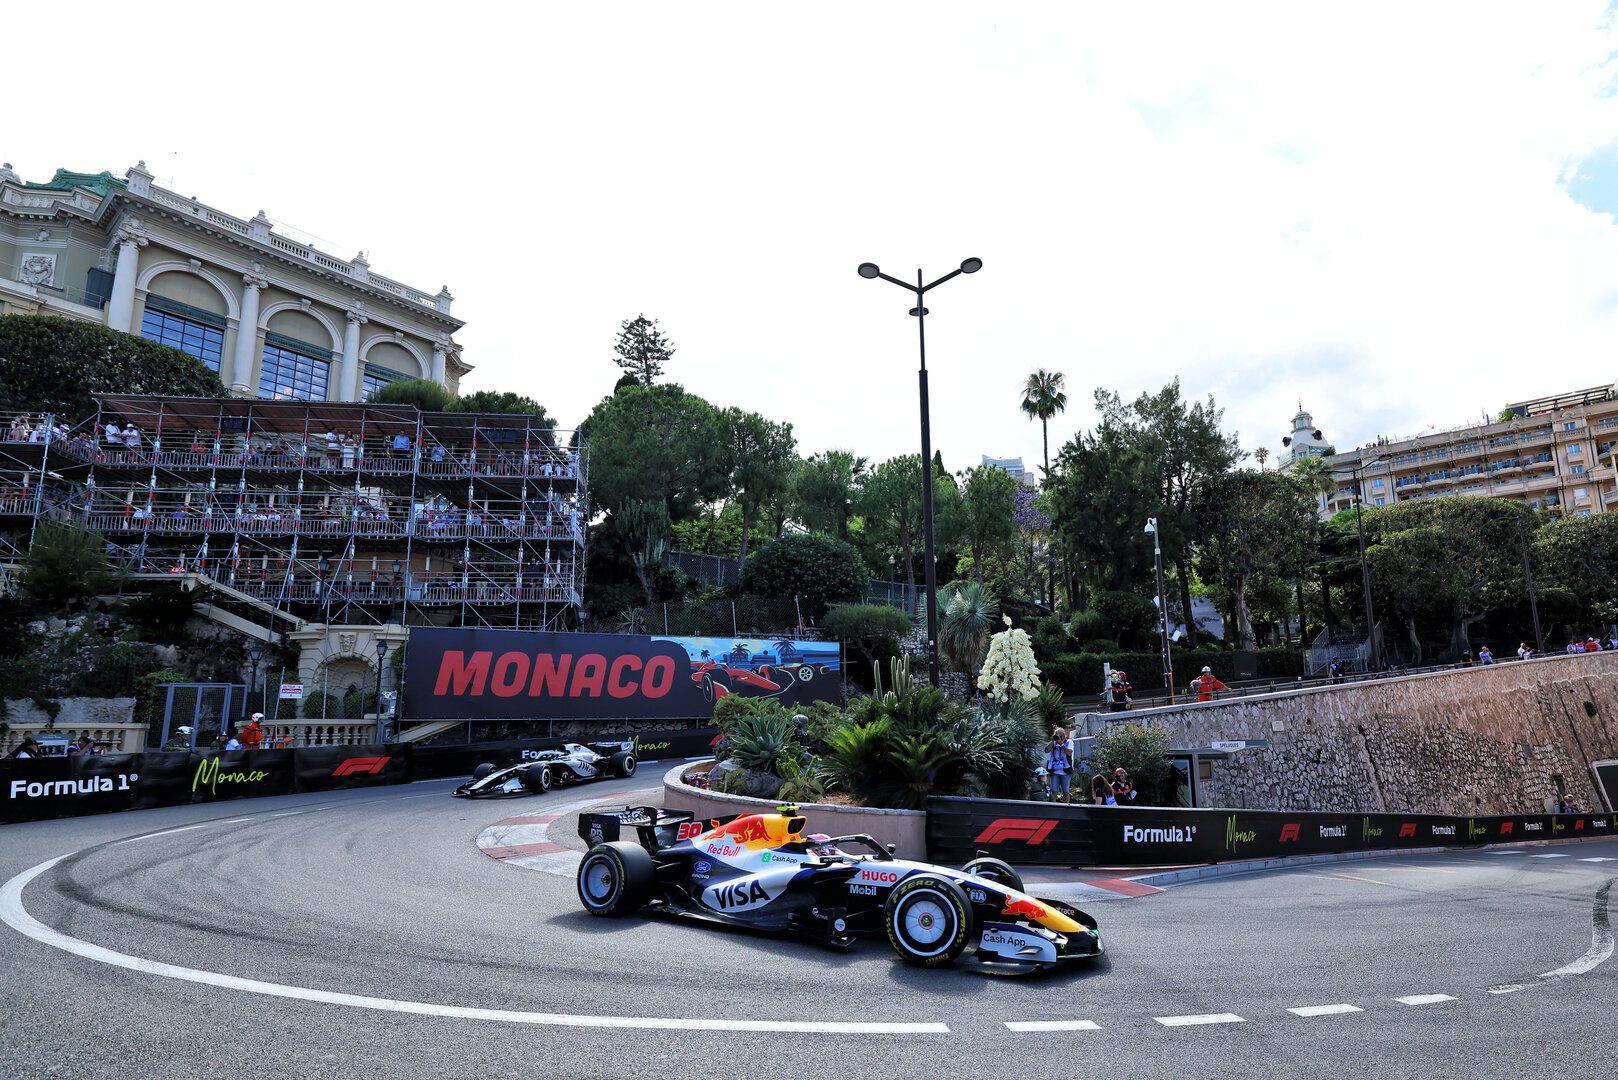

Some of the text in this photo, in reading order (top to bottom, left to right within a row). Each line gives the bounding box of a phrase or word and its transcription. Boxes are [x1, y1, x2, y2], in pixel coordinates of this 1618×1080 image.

[433, 650, 676, 699] MONACO
[628, 735, 670, 757] Monaco
[192, 757, 270, 796] Monaco
[10, 775, 113, 799] Formula
[678, 821, 702, 840] 30
[1123, 825, 1183, 843] Formula
[1226, 814, 1257, 853] Monaco
[1319, 824, 1341, 838] Formula
[1432, 825, 1451, 835] Formula
[707, 843, 741, 857] Red Bull
[771, 855, 785, 863] Cash
[862, 870, 898, 883] HUGO
[712, 879, 771, 909] VISA
[850, 884, 877, 896] Mobil
[900, 880, 935, 895] ZERO
[983, 933, 1026, 947] Cash App
